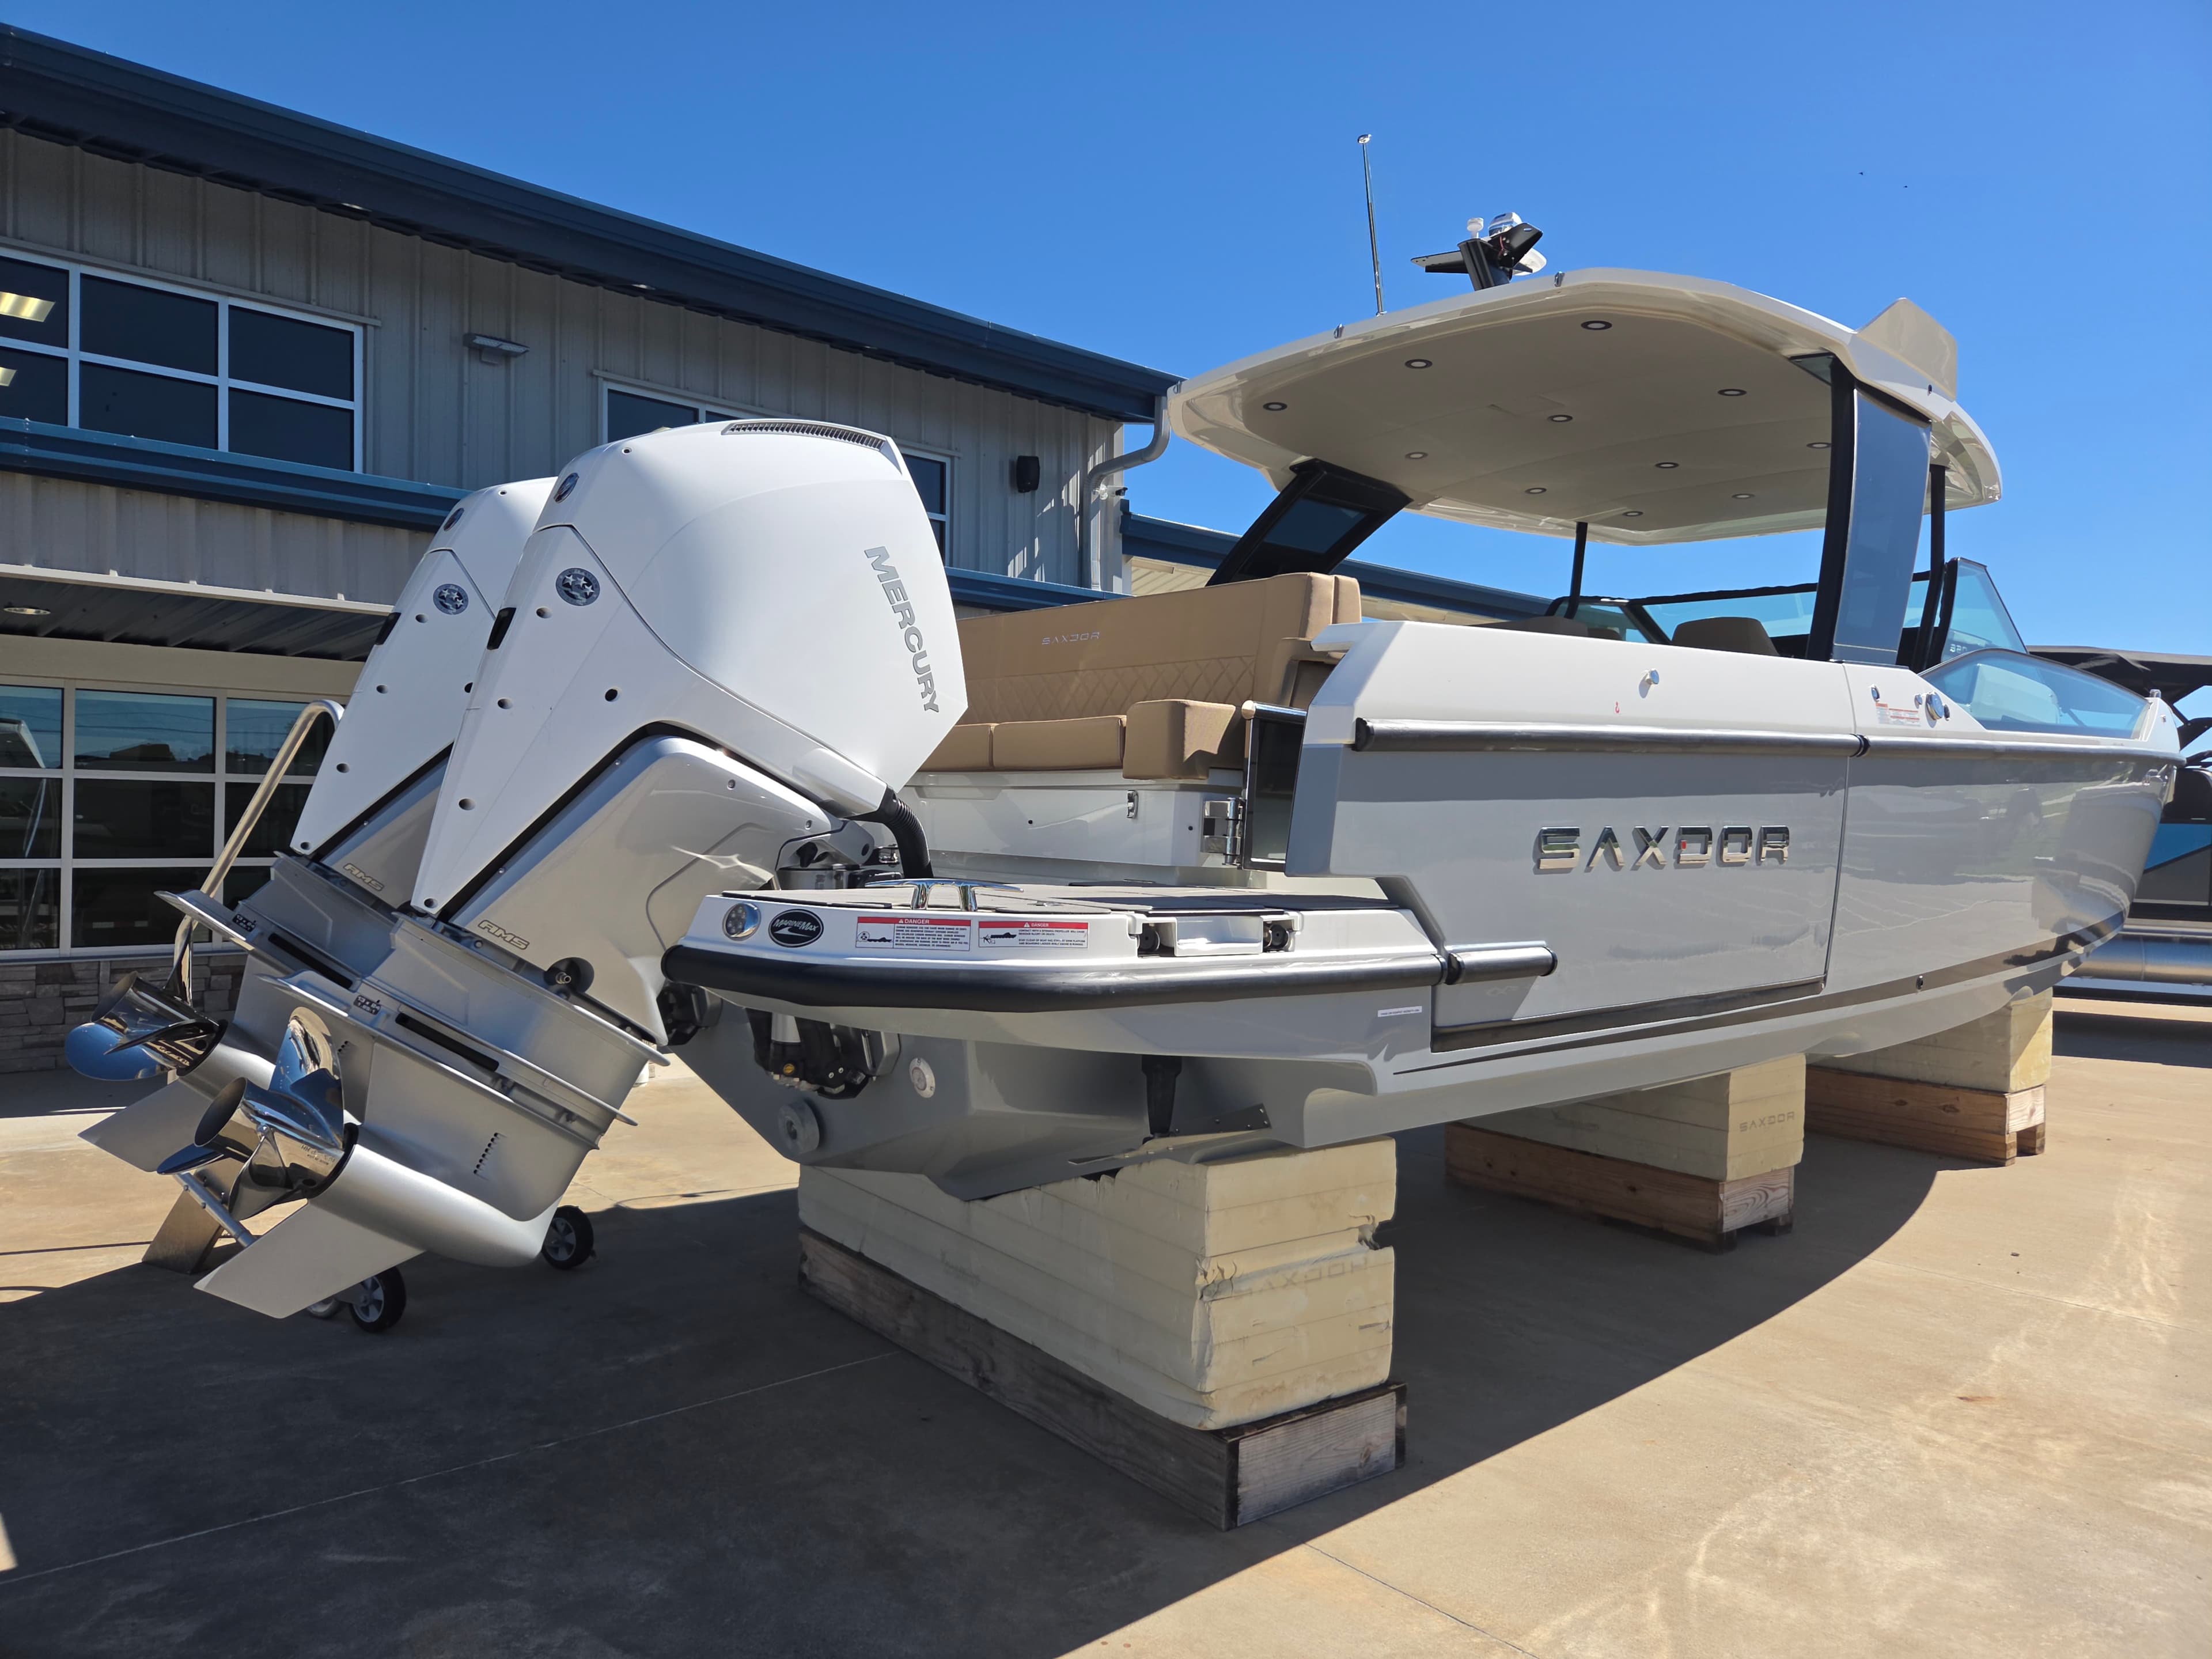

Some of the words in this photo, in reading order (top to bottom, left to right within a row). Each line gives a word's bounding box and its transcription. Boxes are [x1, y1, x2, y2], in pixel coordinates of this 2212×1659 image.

[864, 546, 939, 713] MERCURY
[1041, 632, 1100, 645] SAXDOR
[1539, 825, 1789, 869] SAXDOR
[343, 863, 384, 891] AMS
[478, 919, 530, 950] AMS
[1739, 1111, 1795, 1132] SAXDOR
